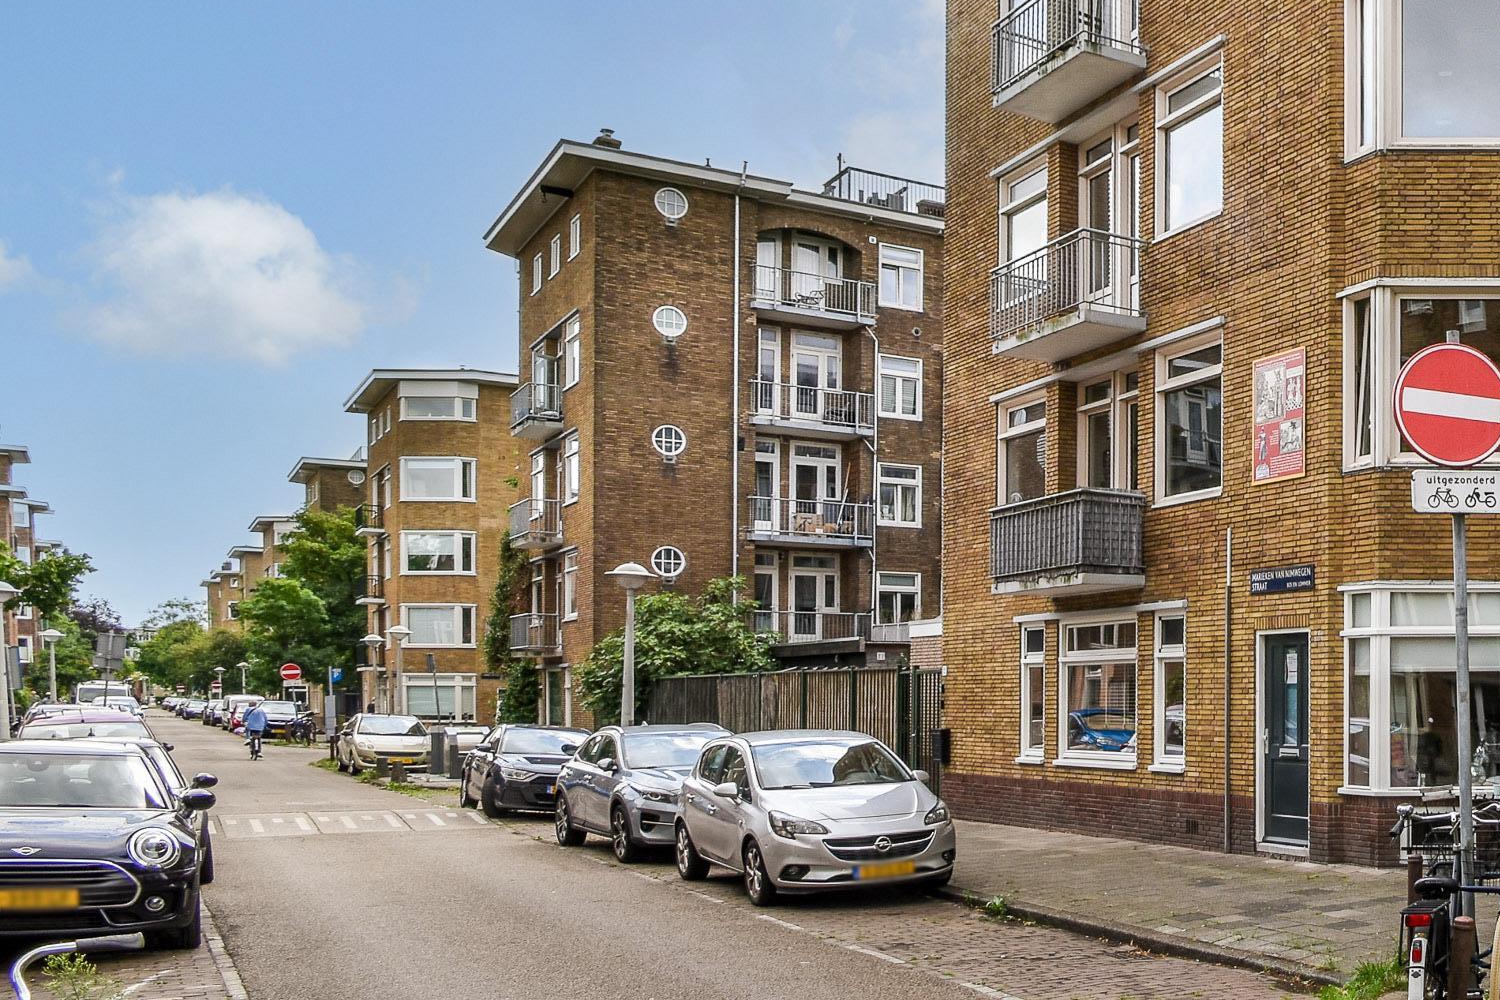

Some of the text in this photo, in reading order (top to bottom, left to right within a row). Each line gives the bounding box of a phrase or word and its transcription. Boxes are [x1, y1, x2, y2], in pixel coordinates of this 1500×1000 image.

[1426, 475, 1496, 486] uitgezonderd
[1251, 567, 1311, 582] MARIEKEN VAN NIMWEGEN
[1251, 582, 1268, 592] STRAAT
